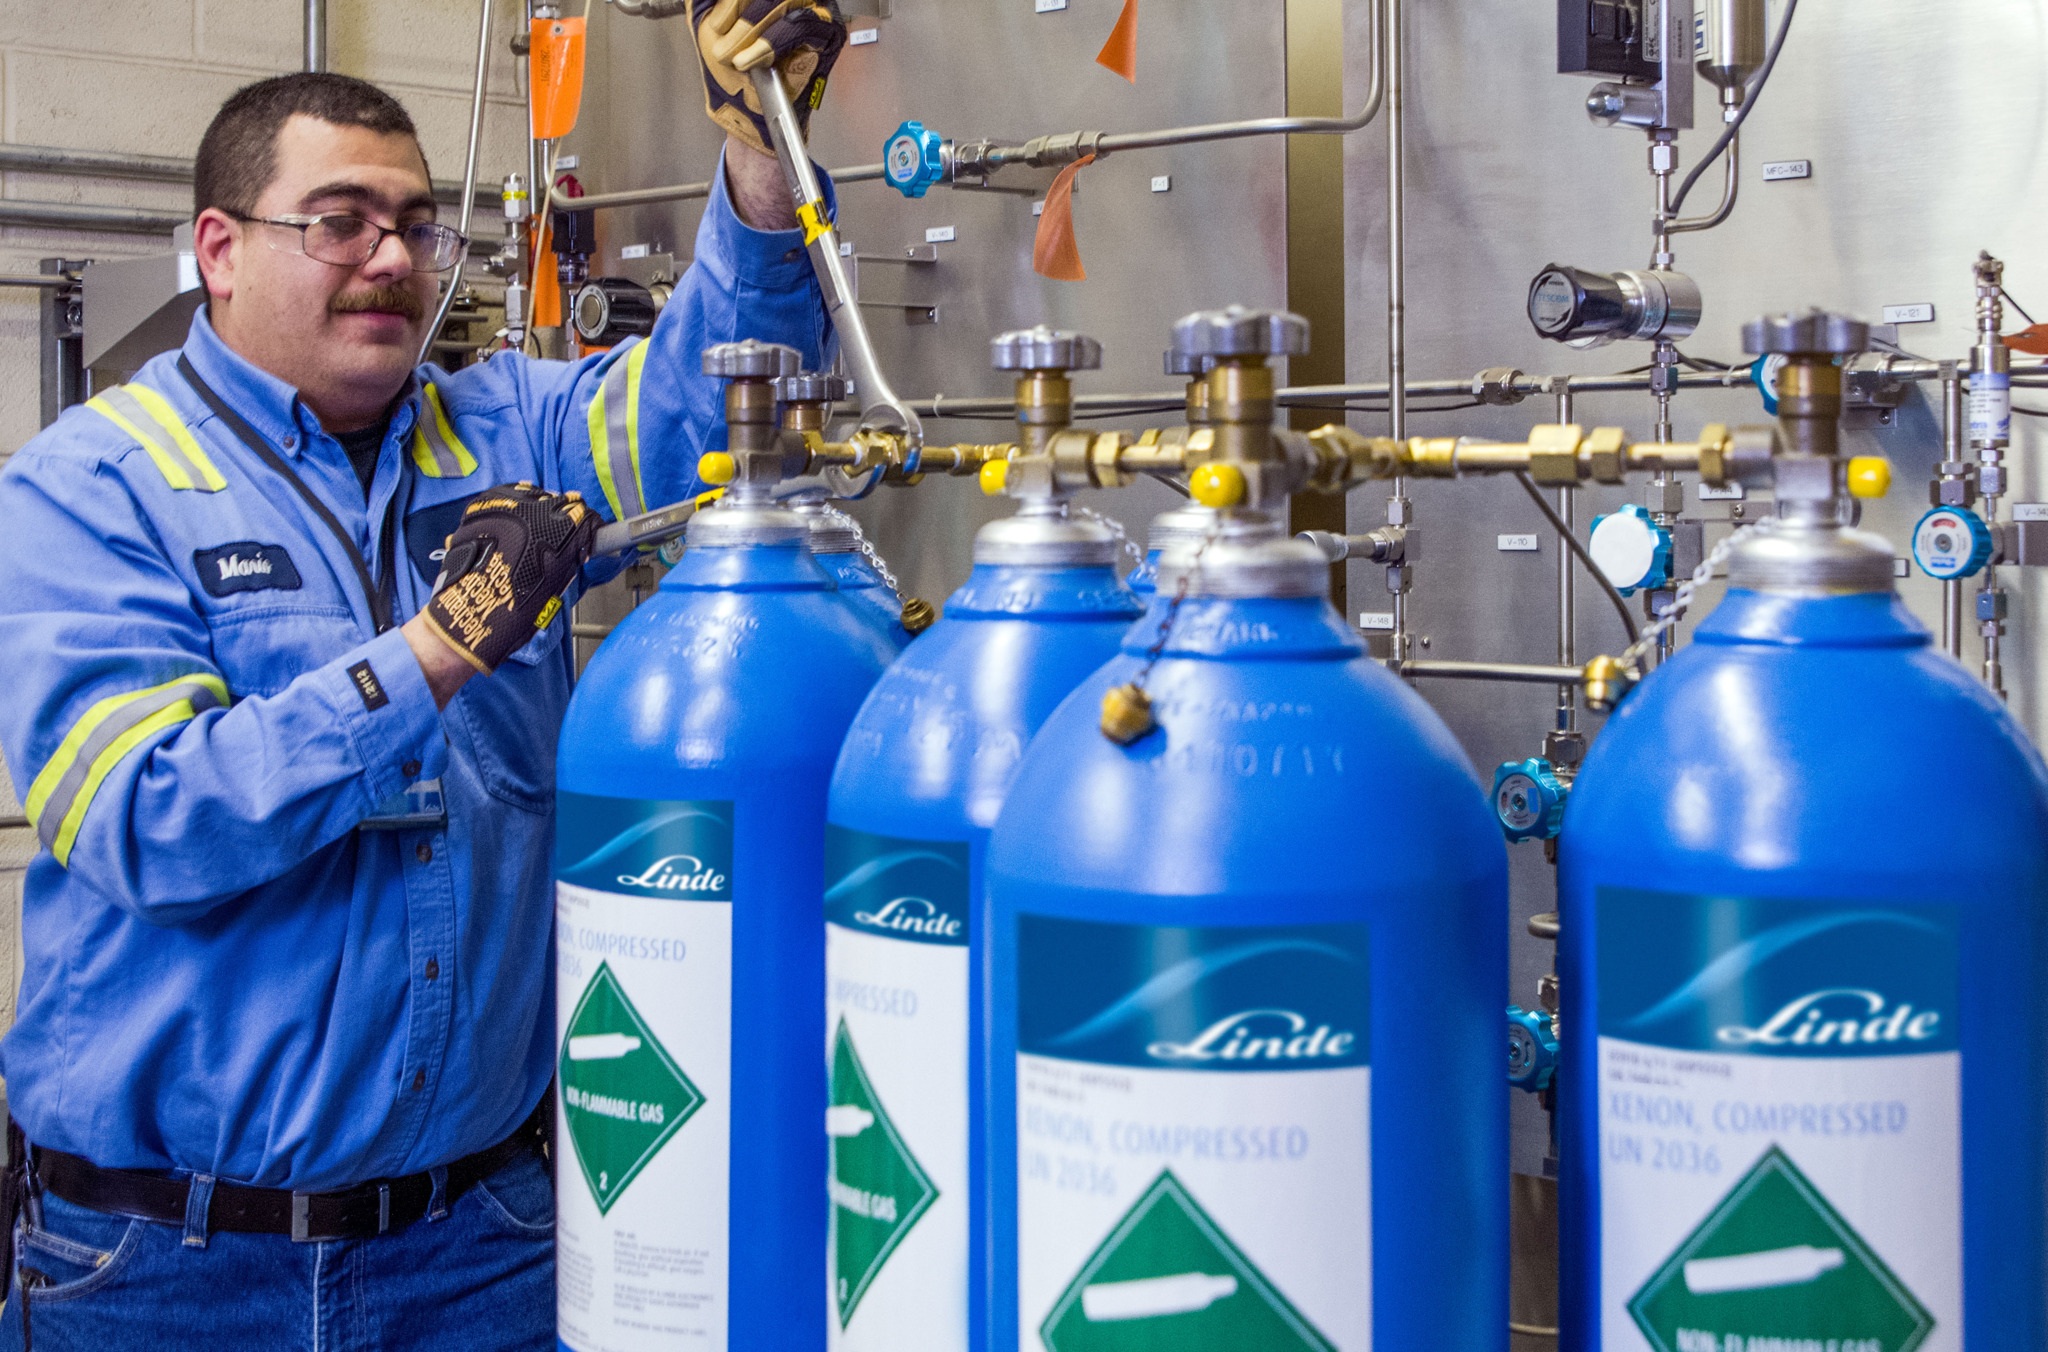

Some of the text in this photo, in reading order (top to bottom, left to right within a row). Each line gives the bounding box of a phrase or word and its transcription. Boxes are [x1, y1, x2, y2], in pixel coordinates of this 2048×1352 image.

[2023, 507, 2048, 517] V-14
[616, 854, 726, 892] Linde
[853, 896, 962, 937] Linde
[578, 927, 688, 962] COMPRESSED
[1146, 1008, 1354, 1060] Linde
[1715, 988, 1940, 1045] Linde
[639, 1101, 665, 1124] GAS
[1609, 1091, 1909, 1137] XENON, COMPRESSED
[1107, 1120, 1310, 1161] COMPRESSED
[1608, 1132, 1723, 1175] UN 2036
[599, 1170, 608, 1191] 2
